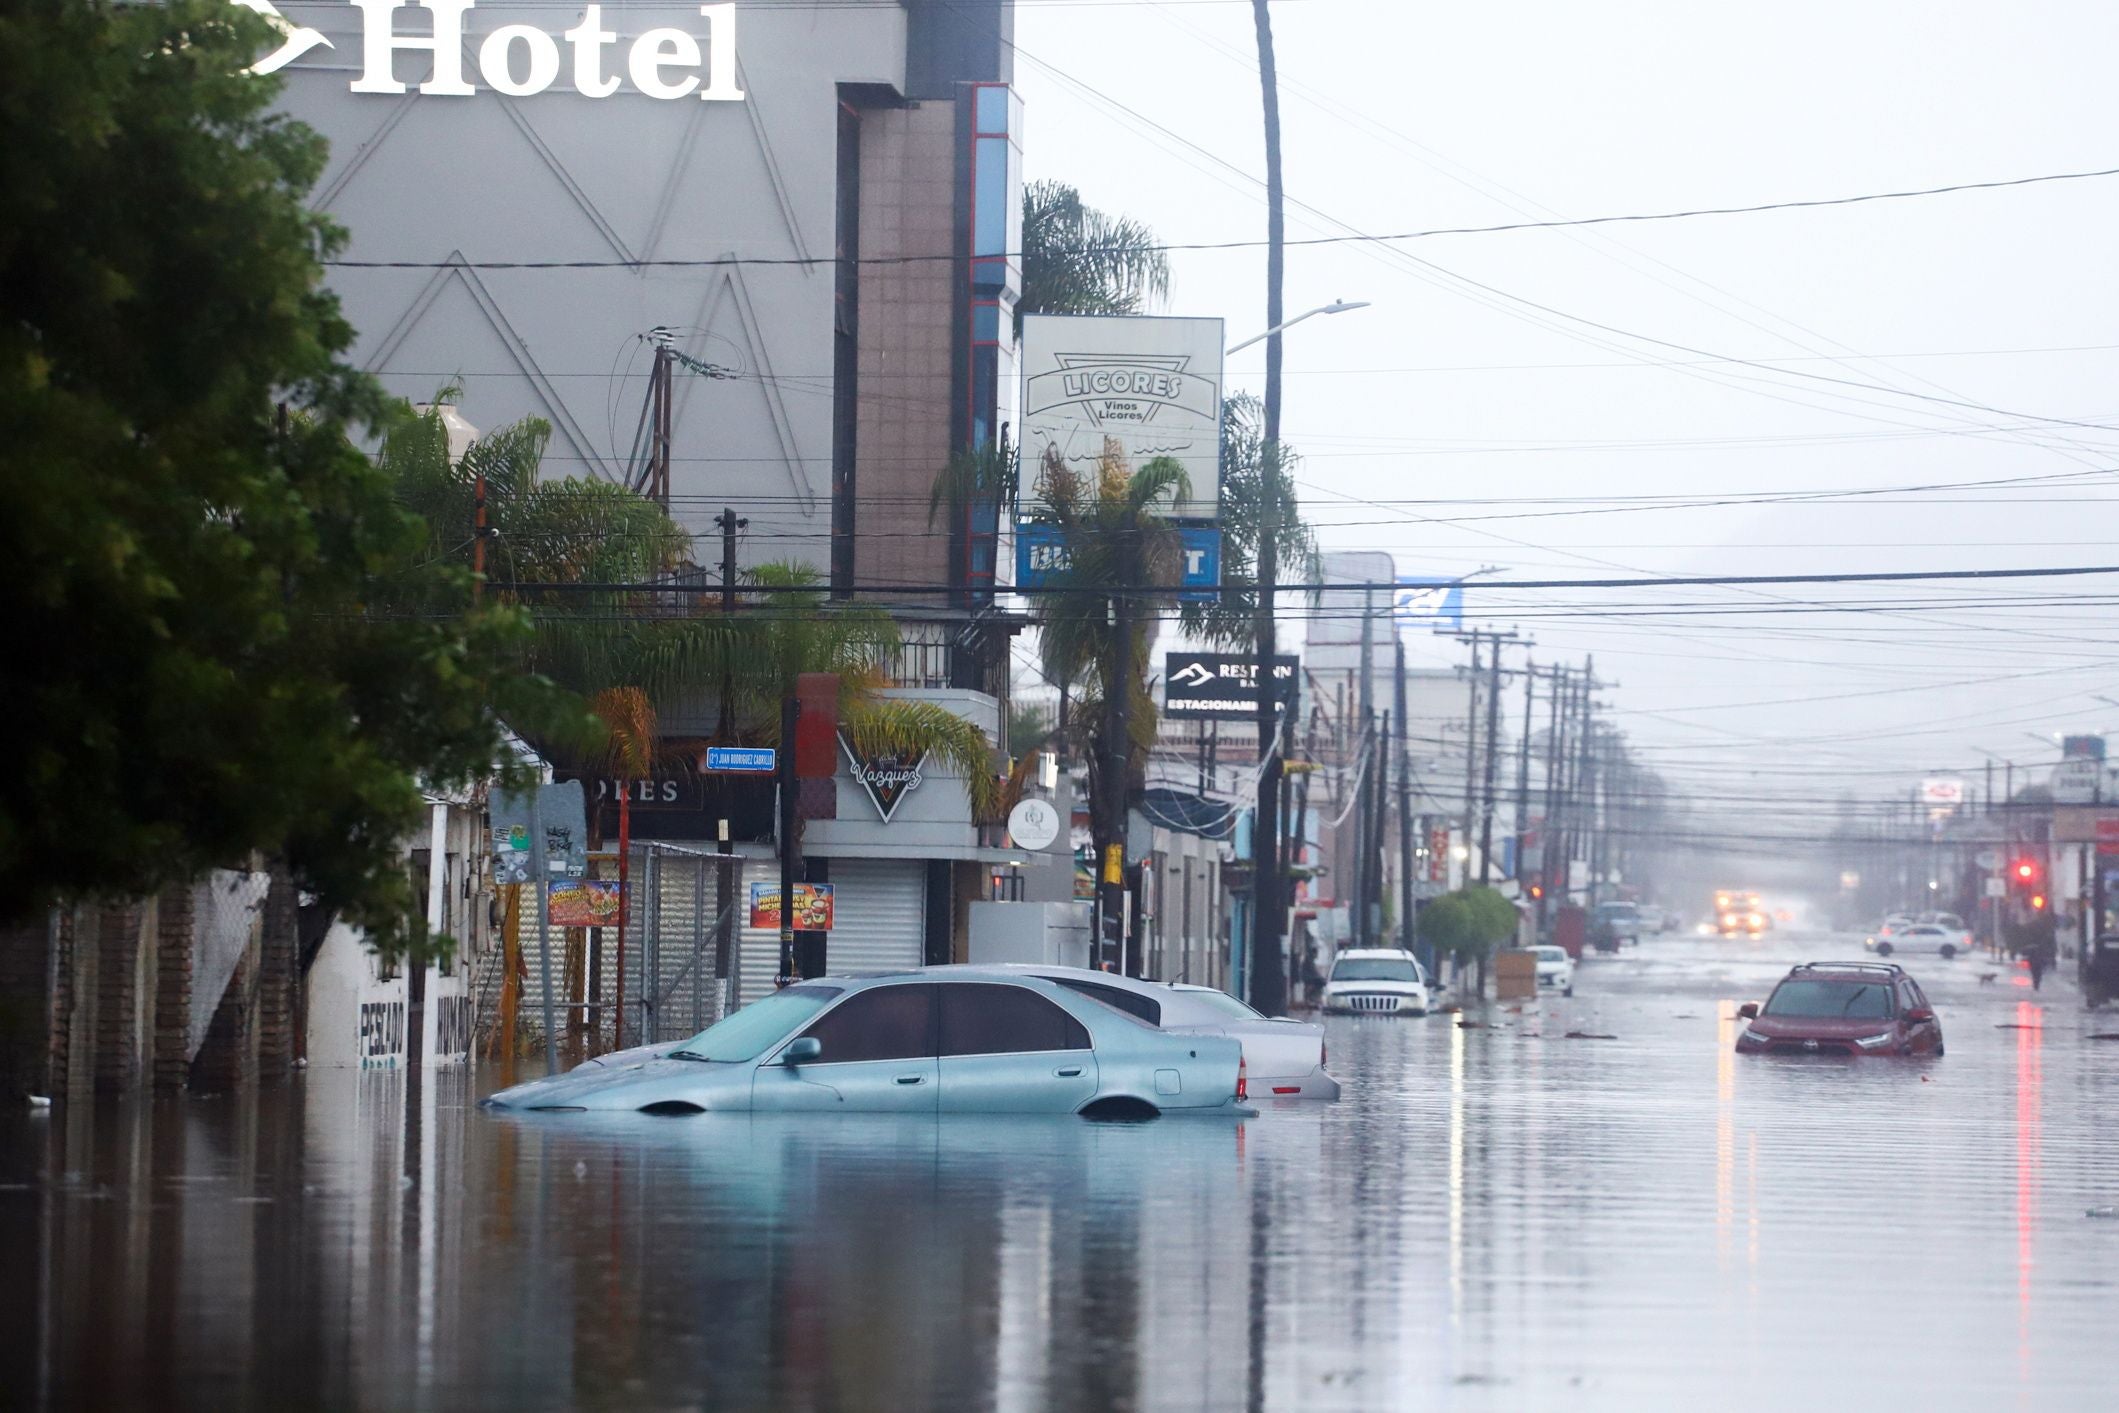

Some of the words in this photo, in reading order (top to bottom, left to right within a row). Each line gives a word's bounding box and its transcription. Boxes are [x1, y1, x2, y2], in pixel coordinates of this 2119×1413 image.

[350, 0, 745, 101] Hotel
[1063, 370, 1182, 399] LICORES
[1098, 410, 1143, 420] Licores
[1104, 401, 1138, 410] Vinos
[719, 753, 730, 764] JUAN
[730, 754, 753, 765] RODRIGUEZ
[852, 762, 918, 789] Vazquez
